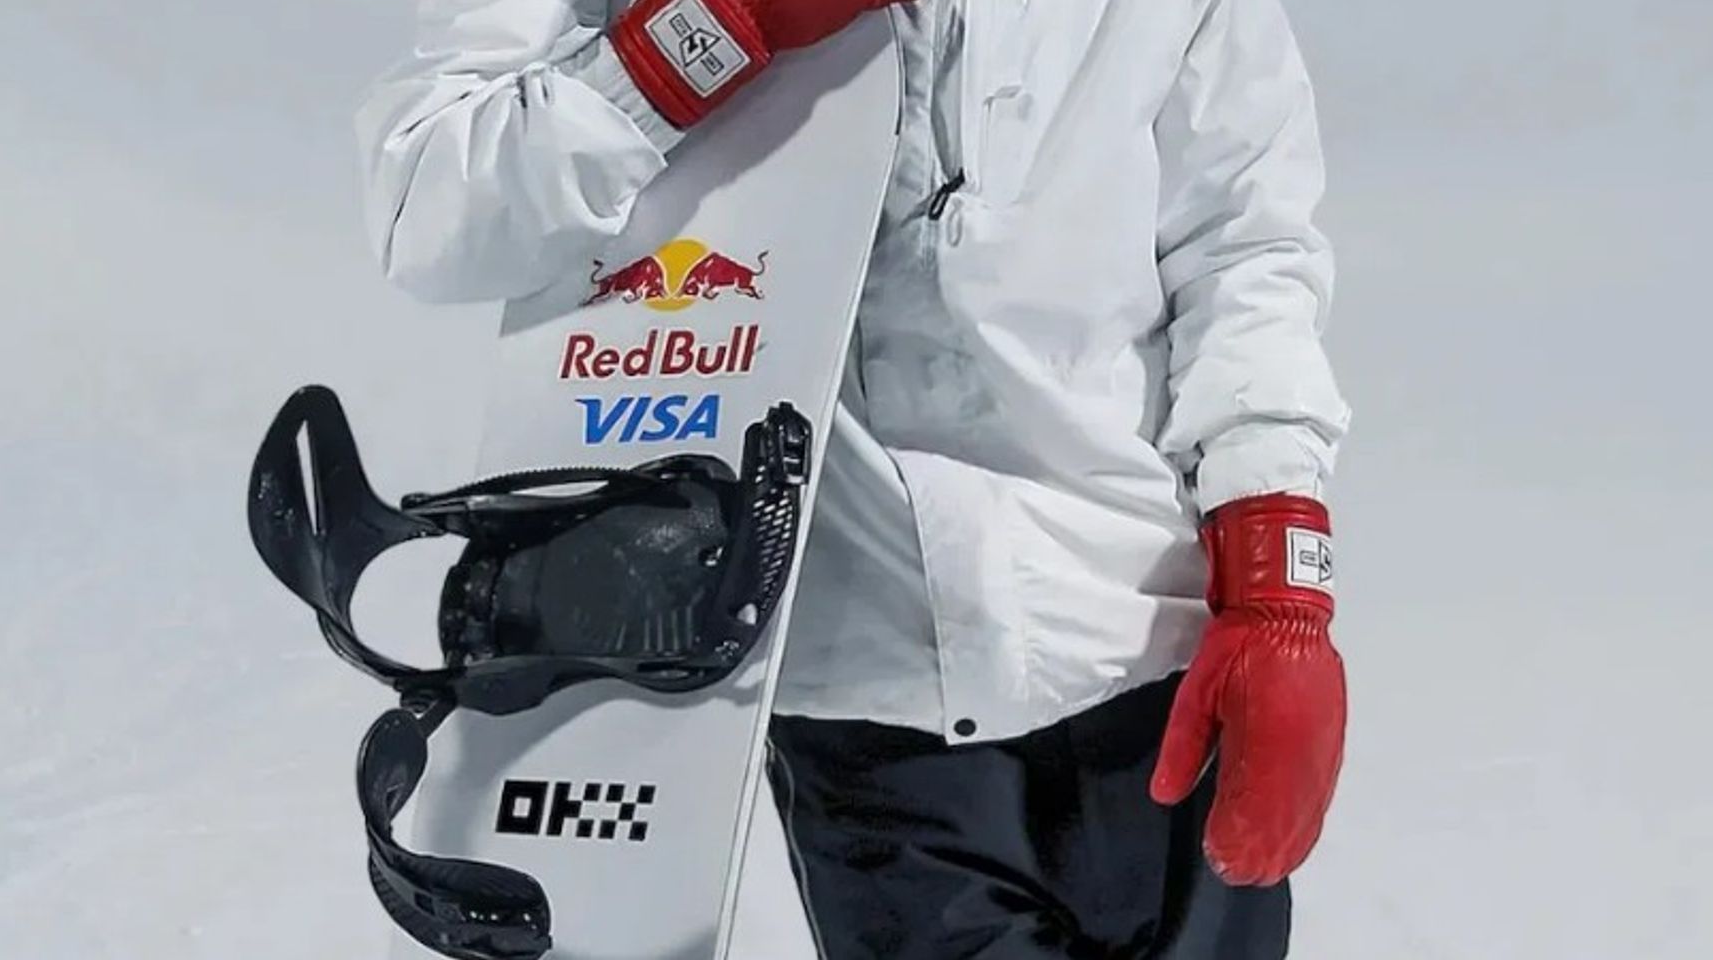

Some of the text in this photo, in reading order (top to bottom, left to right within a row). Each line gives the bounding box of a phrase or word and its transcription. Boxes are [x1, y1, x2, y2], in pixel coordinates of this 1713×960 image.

[560, 324, 759, 380] Red Bull
[575, 394, 721, 445] VISA
[495, 779, 657, 842] OKX
